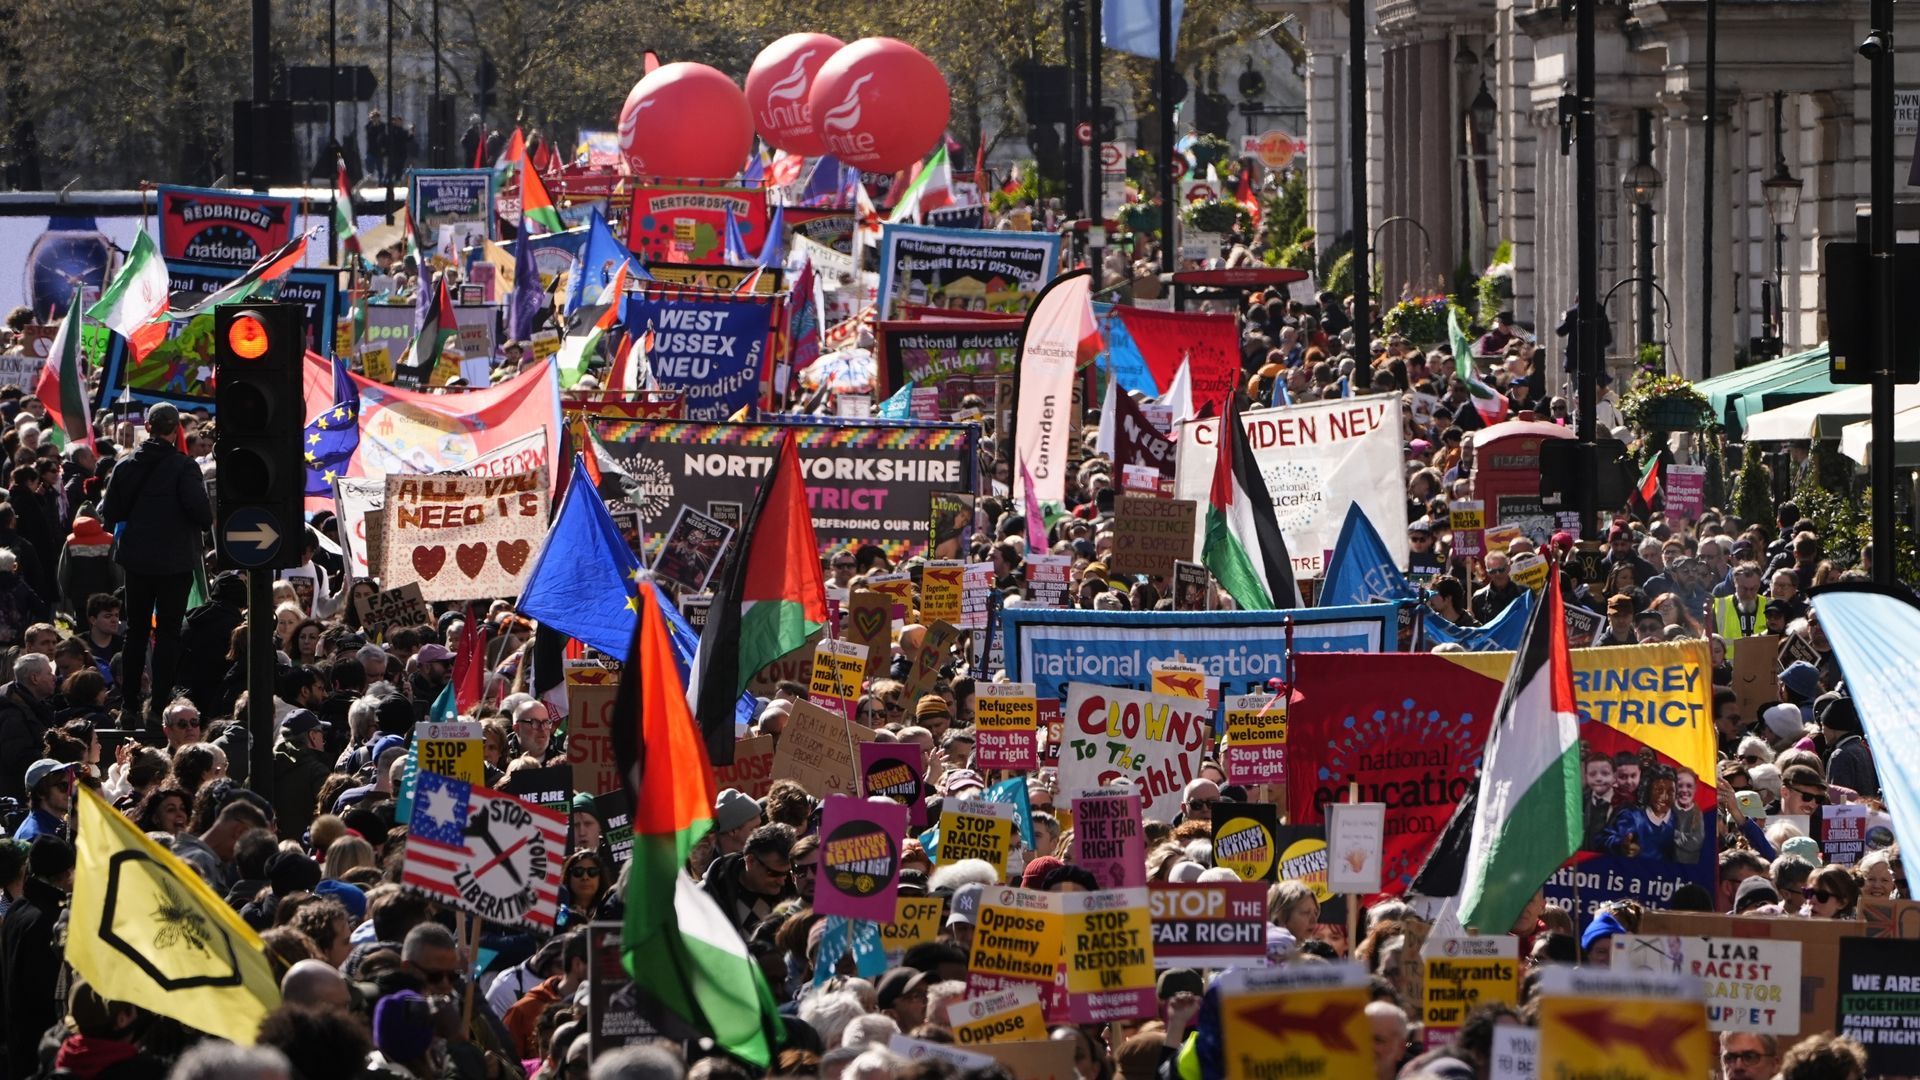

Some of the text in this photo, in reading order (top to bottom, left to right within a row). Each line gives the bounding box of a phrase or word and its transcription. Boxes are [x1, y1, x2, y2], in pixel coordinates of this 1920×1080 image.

[1893, 95, 1919, 106] OWN
[184, 205, 271, 228] REDBRIDGE
[188, 243, 256, 260] national
[900, 240, 1042, 260] national education union
[956, 259, 987, 271] EAST
[988, 261, 1039, 282] DISTRICT
[659, 309, 729, 331] WEST
[654, 333, 736, 357] USSEX
[900, 335, 957, 348] national
[962, 332, 1020, 349] educatio
[656, 357, 710, 379] NEU
[909, 352, 990, 382] WALTHAM
[1035, 395, 1056, 479] Camden
[1195, 416, 1318, 450] CMDEN
[799, 457, 961, 482] YORKSHIRE
[399, 473, 538, 504] ALL YOU
[1270, 482, 1309, 491] national
[1667, 485, 1700, 495] Refugees
[498, 493, 539, 518] IS
[806, 487, 888, 510] TRICT
[1667, 495, 1699, 503] welcome
[1122, 501, 1183, 517] RESPECT
[811, 518, 911, 531] DEFENDING OUR
[1117, 520, 1189, 533] EXISTENCE
[1141, 537, 1188, 550] EXPECT
[1454, 547, 1480, 556] TRUMP
[926, 585, 950, 593] Together
[368, 588, 404, 610] FAR
[945, 601, 958, 609] right
[1575, 619, 1591, 631] YOU
[817, 654, 862, 673] Migrants
[1034, 646, 1140, 677] national
[813, 683, 830, 692] our
[1572, 664, 1700, 692] RINGEY
[979, 700, 1033, 714] Refugees
[1576, 700, 1703, 729] STRICT
[979, 715, 1031, 725] welcome
[1078, 695, 1205, 752] CLOWNS
[1229, 713, 1287, 730] Refugees
[980, 733, 1029, 747] Stop the
[1230, 725, 1284, 741] welcome
[425, 742, 467, 759] STOP
[980, 748, 1029, 762] far right
[1231, 747, 1284, 763] Stop the
[1359, 744, 1449, 771] national
[426, 760, 456, 776] THE
[1231, 762, 1284, 779] far right
[541, 790, 565, 802] ARE
[1313, 770, 1471, 815] educatio
[490, 799, 532, 829] STOP
[1080, 799, 1128, 820] SMASH
[607, 815, 628, 829] WE
[956, 816, 995, 833] STOP
[1081, 820, 1136, 839] THE FAR
[1383, 815, 1436, 836] nion
[947, 831, 1000, 849] RACIST
[1082, 840, 1125, 859] RIGHT
[1217, 833, 1264, 858] AGAINST
[527, 831, 547, 880] YOUR
[826, 843, 887, 866] AGAINST
[1283, 849, 1327, 869] EDUCATOR
[851, 857, 891, 876] FAR RIGHT
[1607, 871, 1692, 901] is a righ
[902, 904, 937, 920] OFF
[1151, 891, 1261, 917] STOP THE
[981, 908, 1045, 932] Oppose
[1084, 912, 1129, 931] STOP
[1078, 931, 1139, 951] RACIST
[1152, 923, 1261, 943] FAR RIGHT
[978, 930, 1039, 957] Tommy
[1708, 943, 1758, 961] LIAR
[974, 952, 1053, 976] Robinson
[1074, 949, 1145, 971] REFORM
[1101, 970, 1122, 987] UK
[1430, 963, 1512, 983] Migrants
[1691, 960, 1772, 980] RACIST
[1430, 984, 1479, 1001] make
[1703, 981, 1782, 1002] RAITOR
[1852, 974, 1920, 992] WE ARE
[1087, 992, 1138, 1007] Refugees
[1847, 997, 1920, 1012] TOGETHE
[1090, 1004, 1138, 1019] welcome
[1429, 1007, 1458, 1022] our
[1707, 1006, 1776, 1025] UPPET
[1843, 1014, 1899, 1028] AGAINST
[959, 1015, 1024, 1044] Oppose
